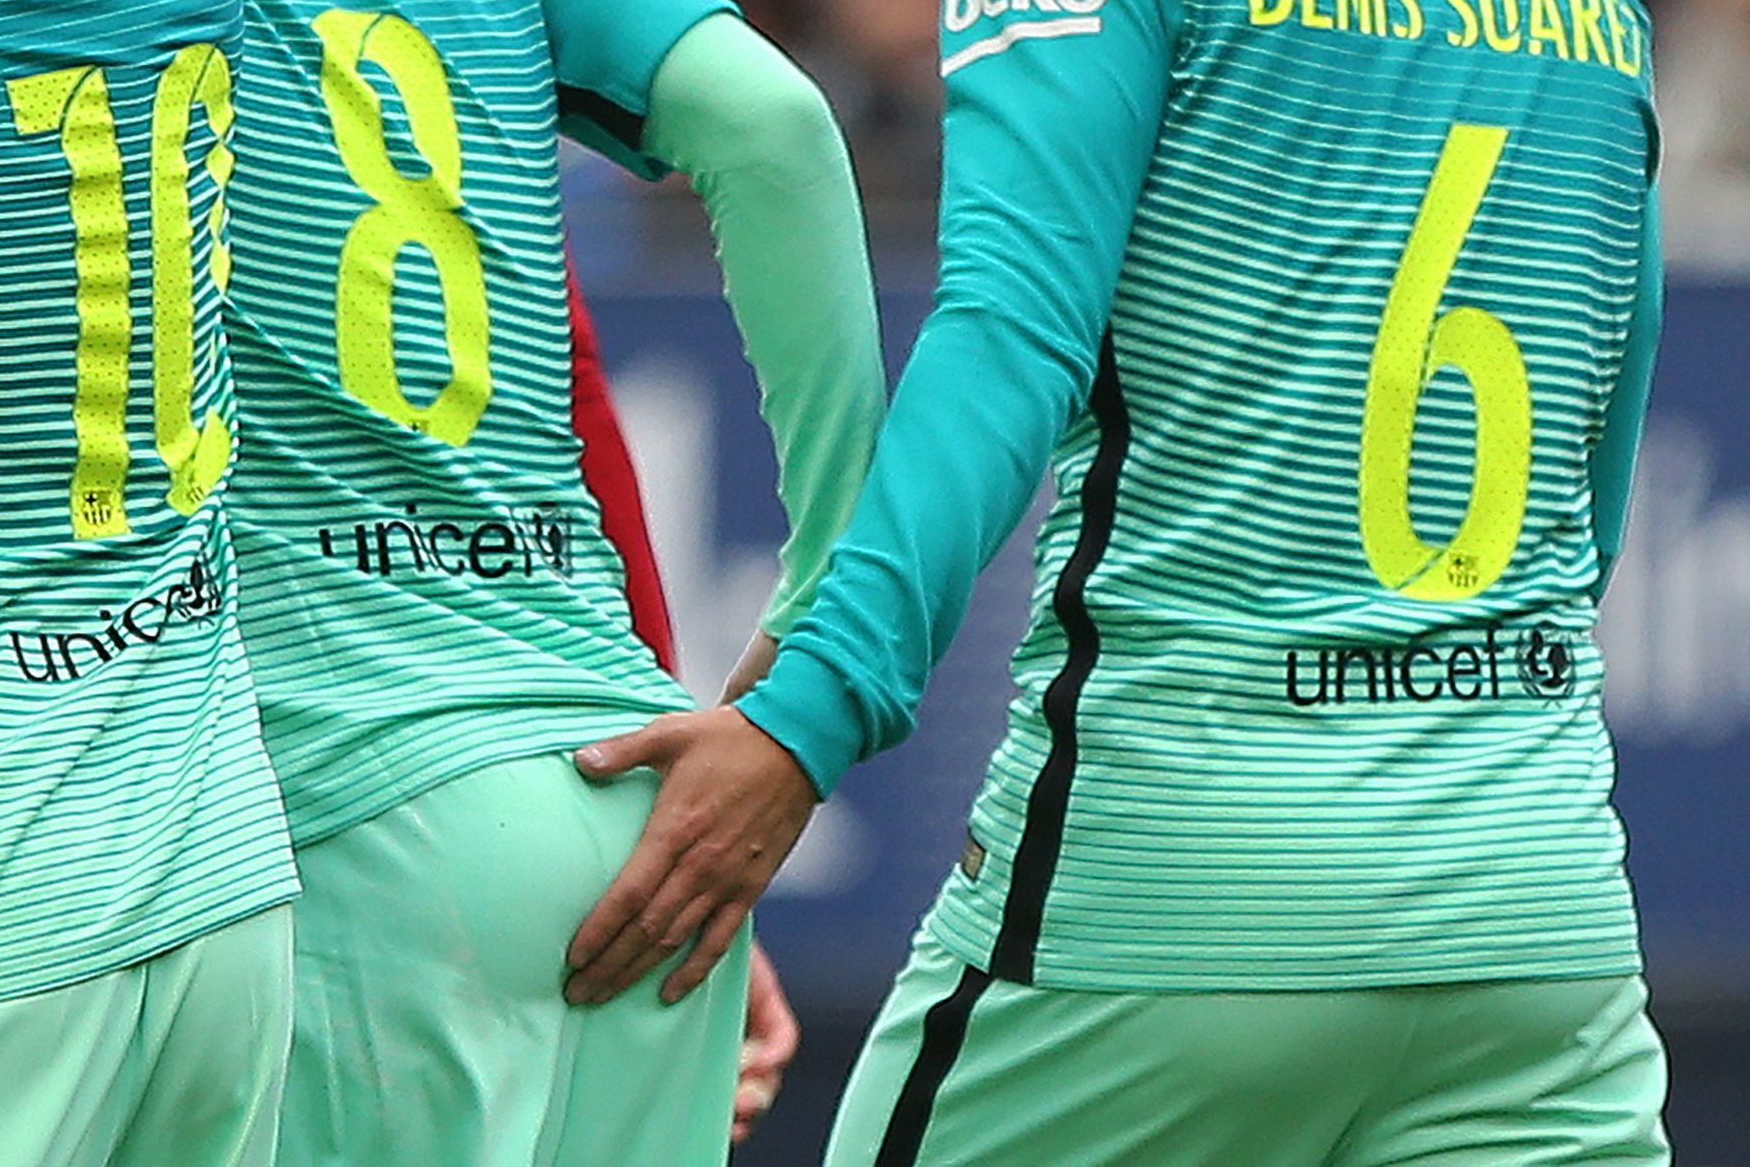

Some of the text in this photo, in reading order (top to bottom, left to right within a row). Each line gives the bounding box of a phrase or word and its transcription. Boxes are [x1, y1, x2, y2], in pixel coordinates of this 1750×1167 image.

[6, 43, 237, 539] 10
[311, 8, 492, 447] 8
[1359, 124, 1532, 602] 6
[1286, 628, 1506, 706] unicef
